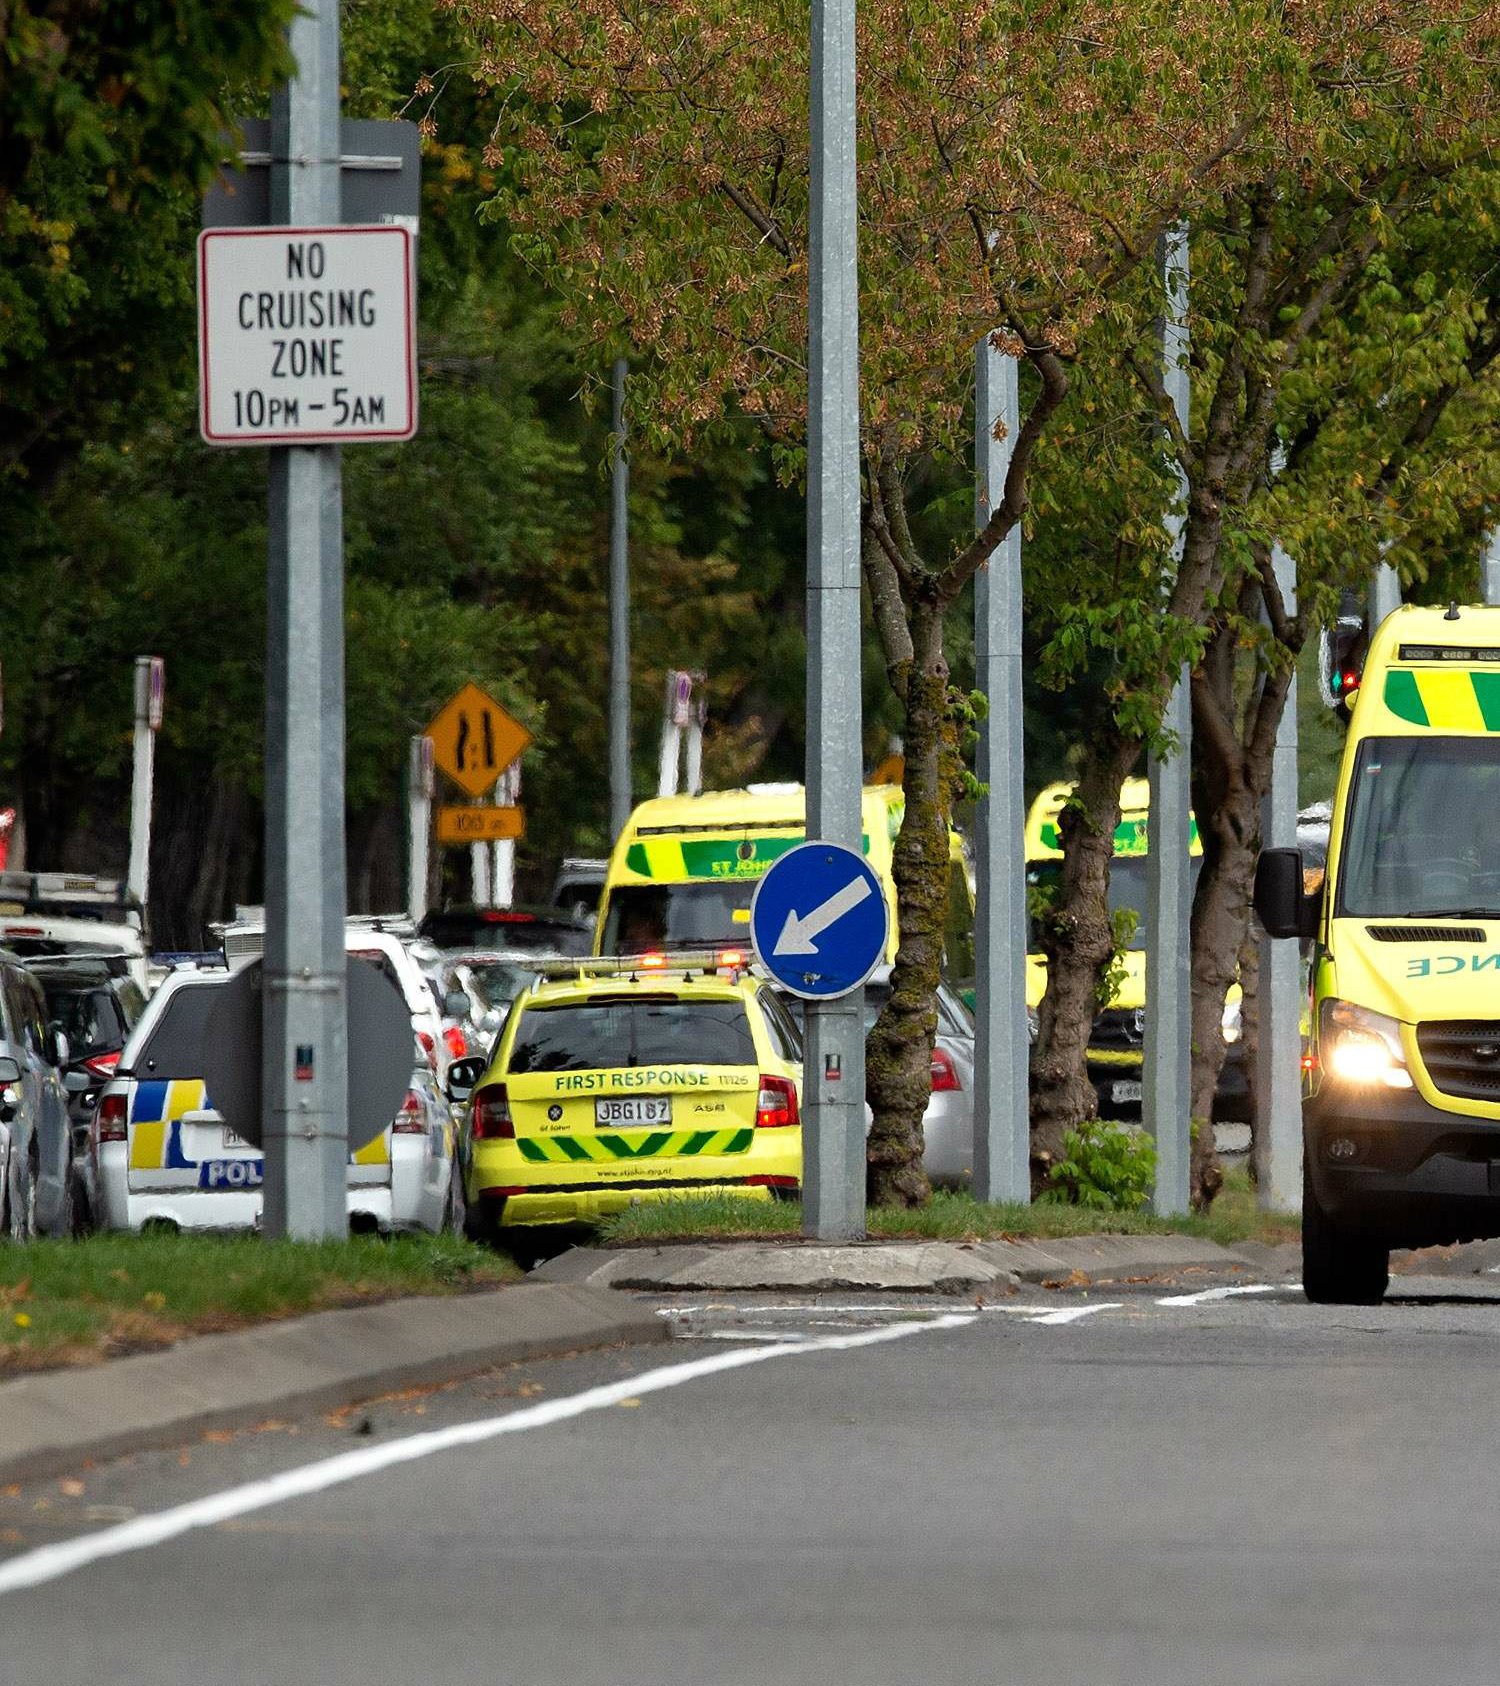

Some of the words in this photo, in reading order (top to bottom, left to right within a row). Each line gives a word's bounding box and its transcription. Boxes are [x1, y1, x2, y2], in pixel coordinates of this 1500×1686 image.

[286, 242, 325, 281] NO
[238, 288, 376, 330] CRUISING
[271, 338, 344, 378] ZONE
[735, 859, 774, 875] JOH
[556, 1073, 607, 1091] FIRST
[611, 1069, 710, 1088] RESPONSE
[598, 1102, 669, 1121] JBG187
[208, 1162, 264, 1187] POL
